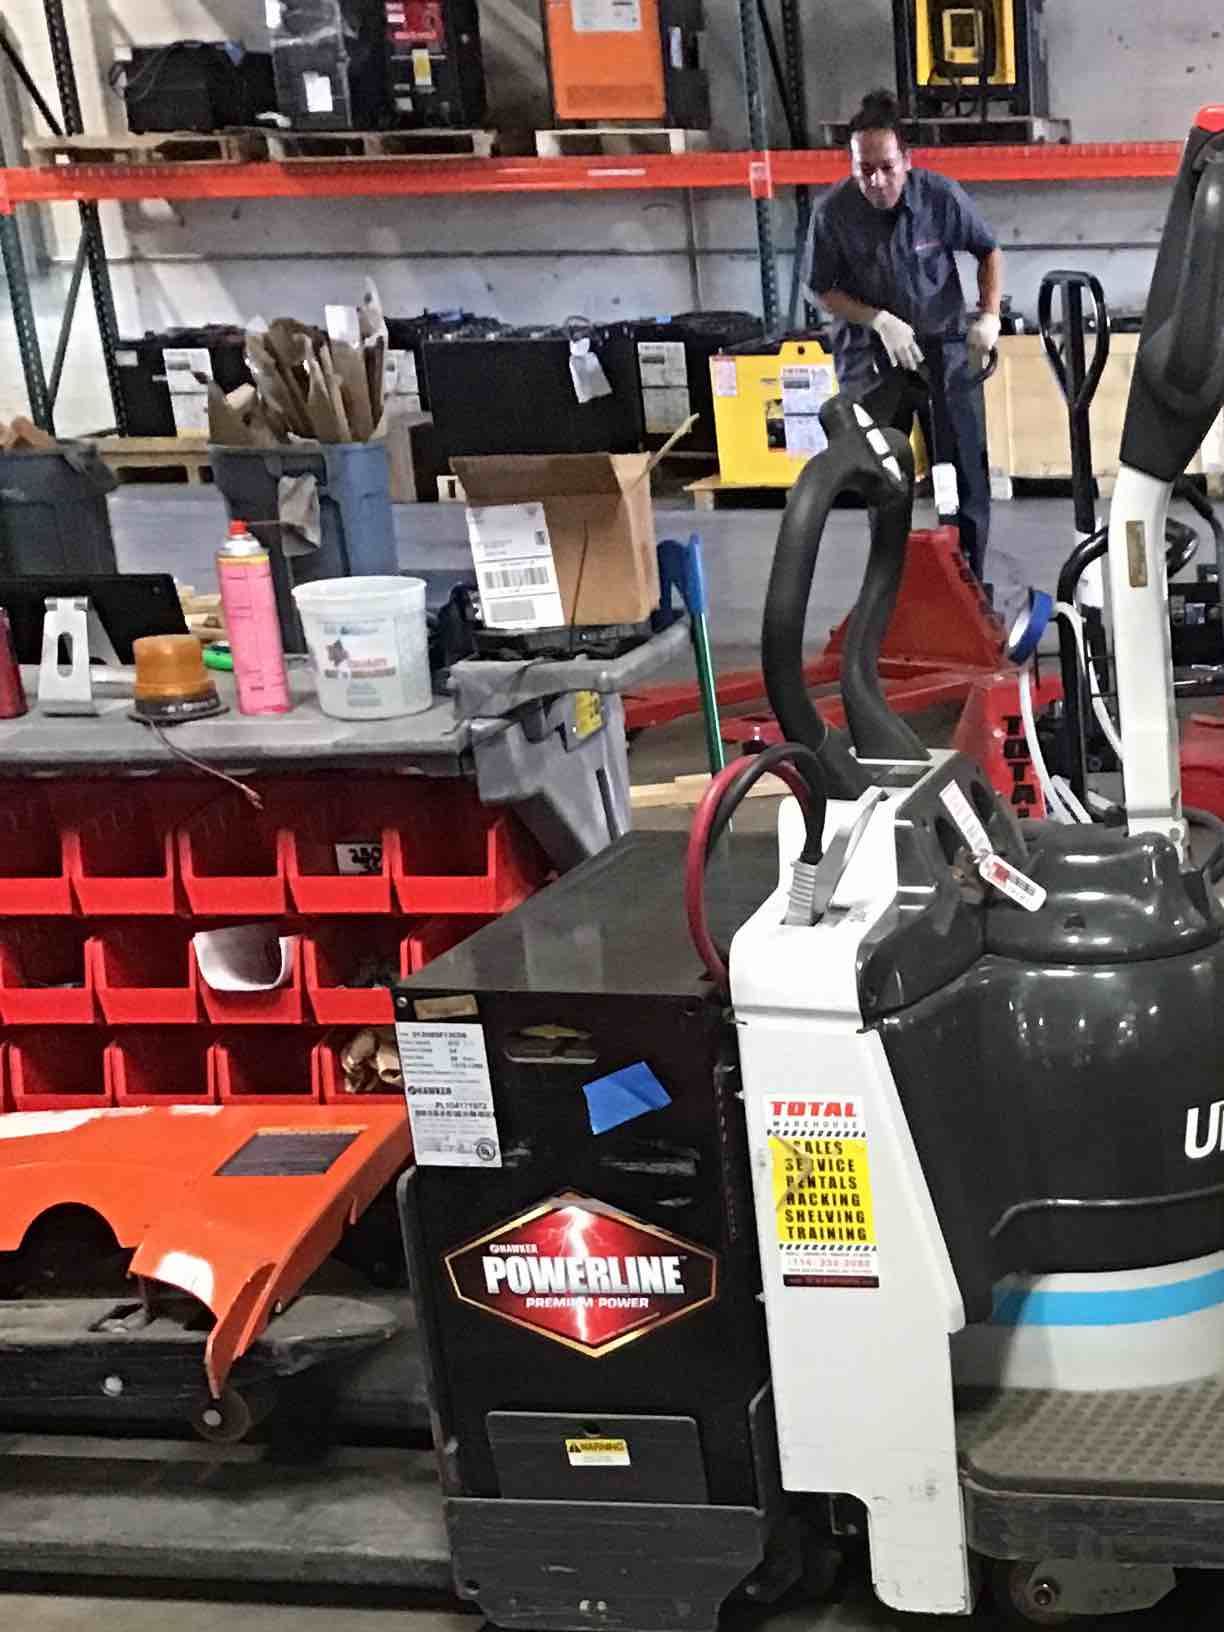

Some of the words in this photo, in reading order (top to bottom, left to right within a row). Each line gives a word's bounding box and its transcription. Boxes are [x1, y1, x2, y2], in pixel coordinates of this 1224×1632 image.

[769, 1100, 858, 1118] TOTAL
[772, 1119, 857, 1129] WAREHOUSE
[793, 1140, 843, 1155] SALES
[786, 1192, 860, 1207] RACKING
[784, 1209, 865, 1224] SHELVING
[786, 1226, 867, 1241] TRAINING
[499, 1244, 539, 1254] HAWKER
[482, 1255, 685, 1295] POWERLINE
[526, 1297, 594, 1309] PREMIUM
[598, 1297, 650, 1309] POWER
